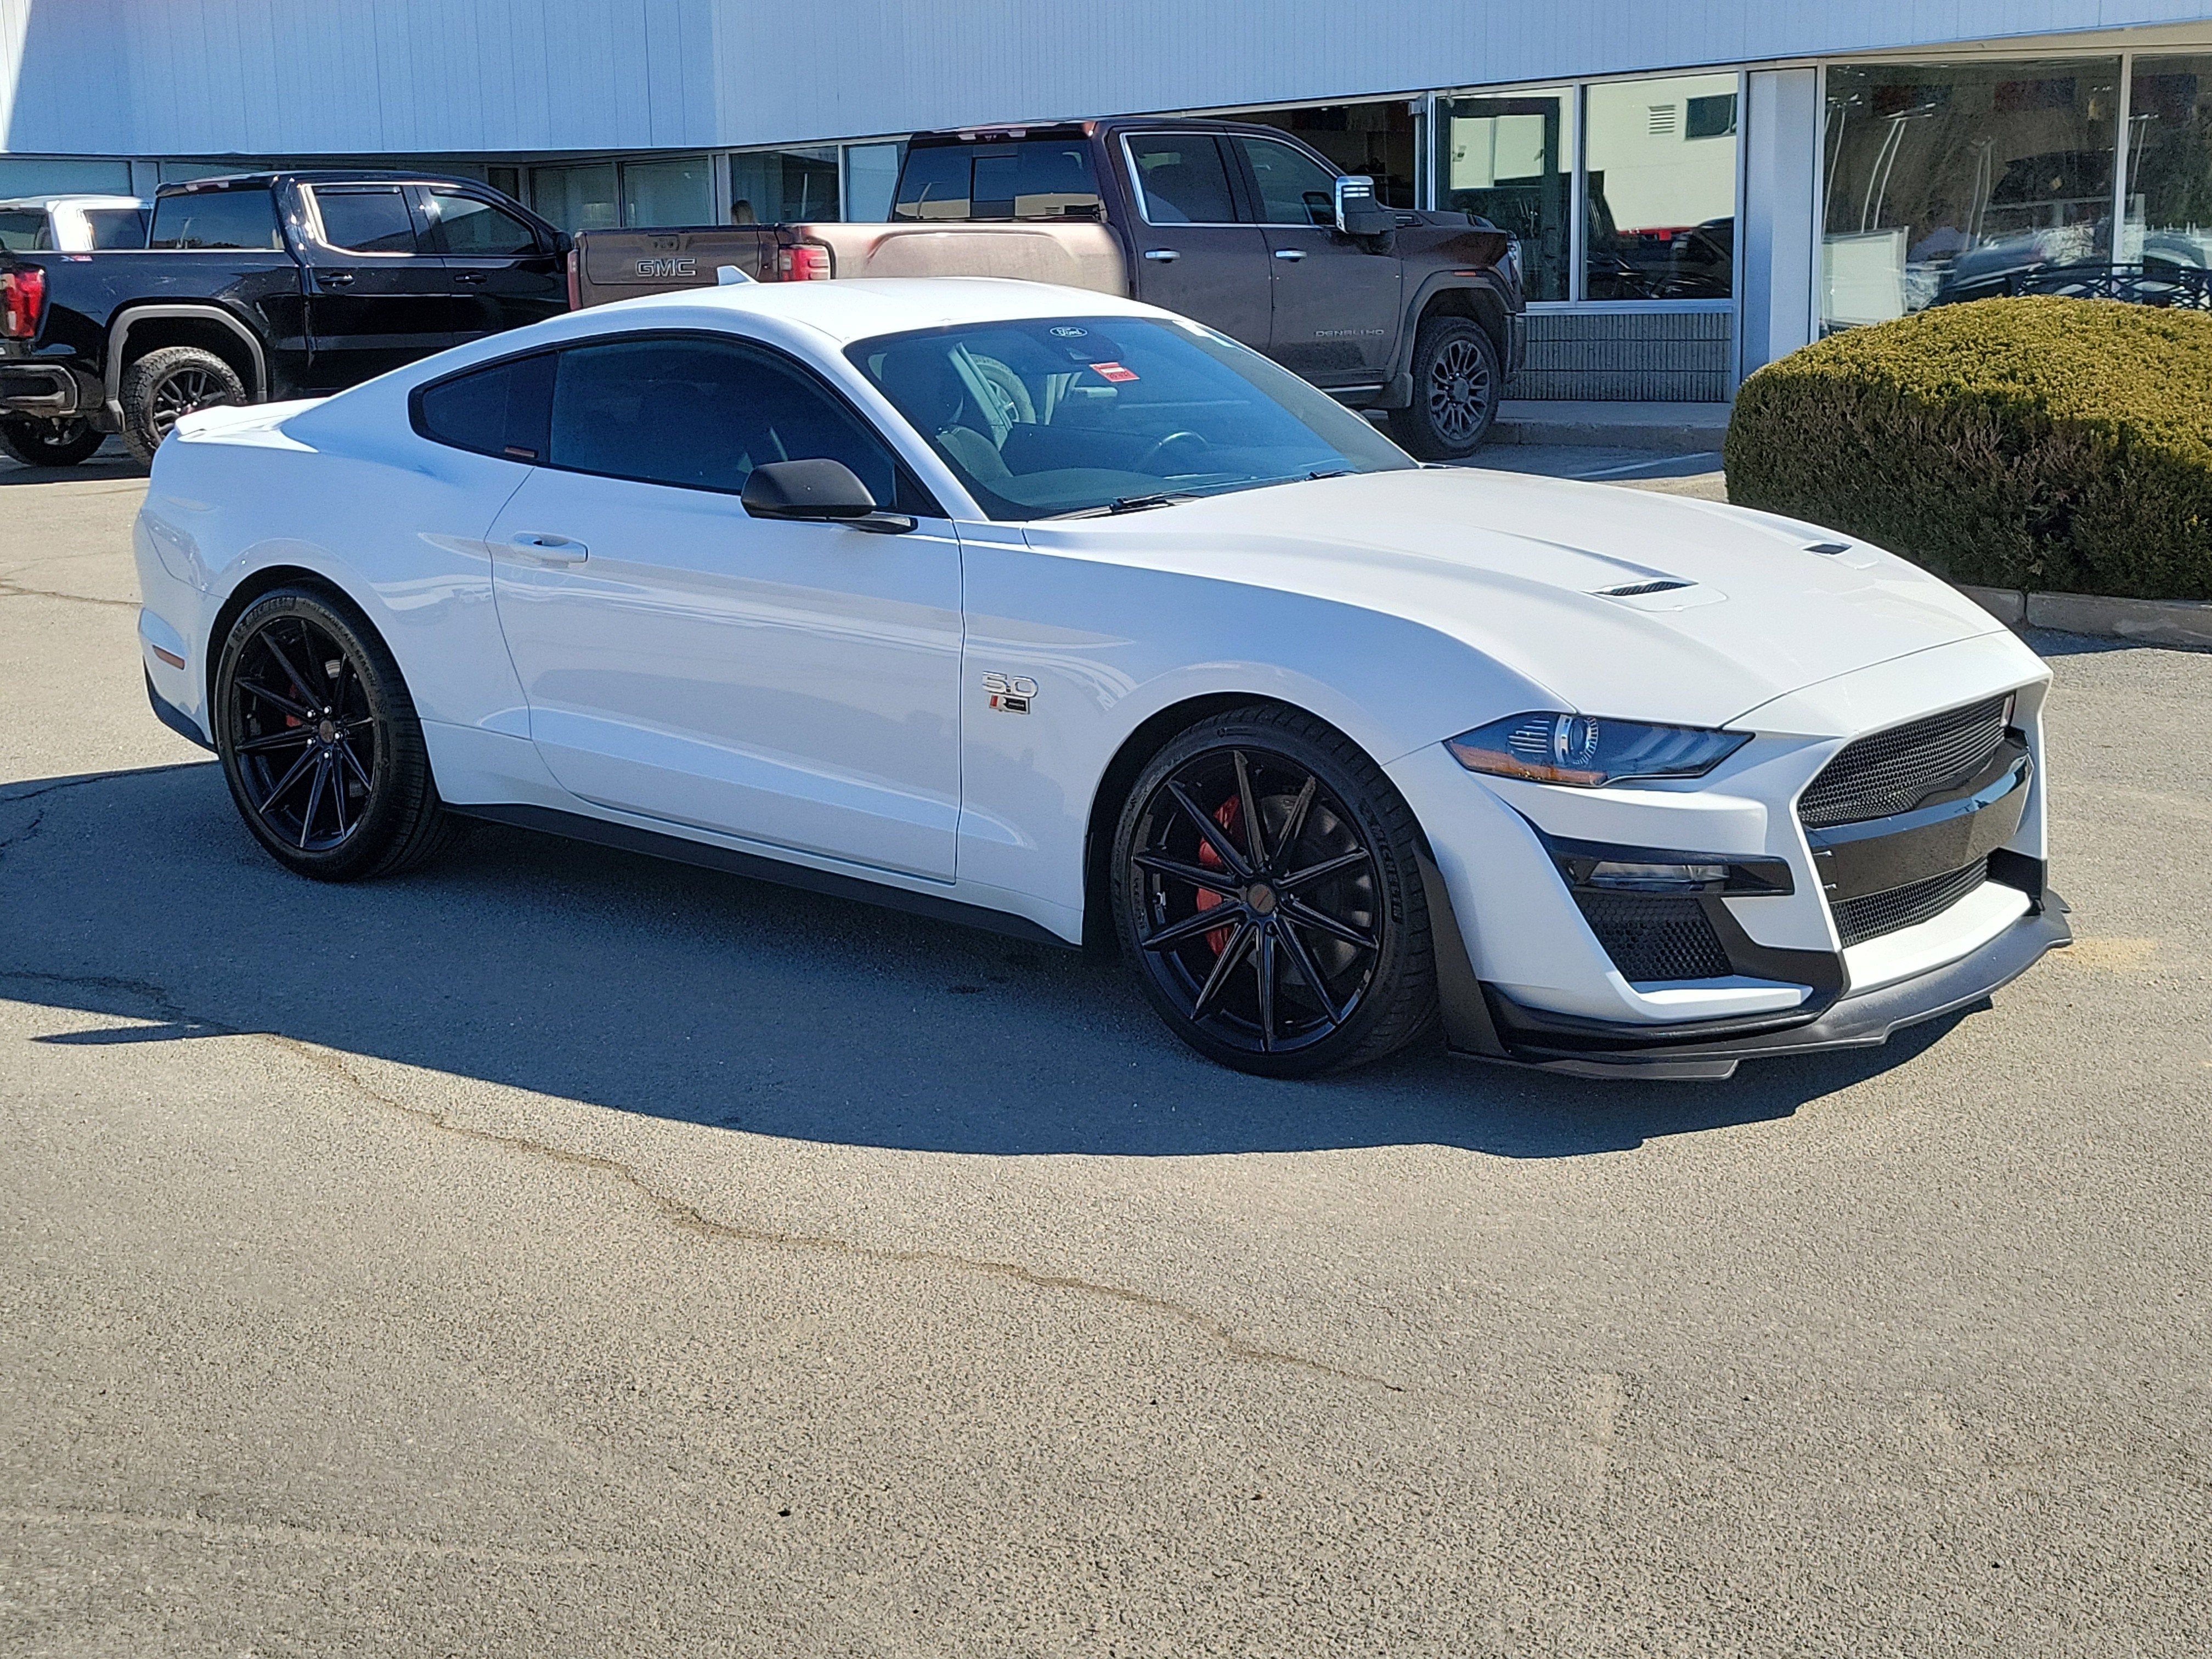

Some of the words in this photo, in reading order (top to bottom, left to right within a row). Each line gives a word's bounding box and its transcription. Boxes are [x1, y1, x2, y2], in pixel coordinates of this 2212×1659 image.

[636, 258, 697, 276] GMC
[1055, 328, 1083, 336] Ford
[982, 670, 1039, 698] 5.0
